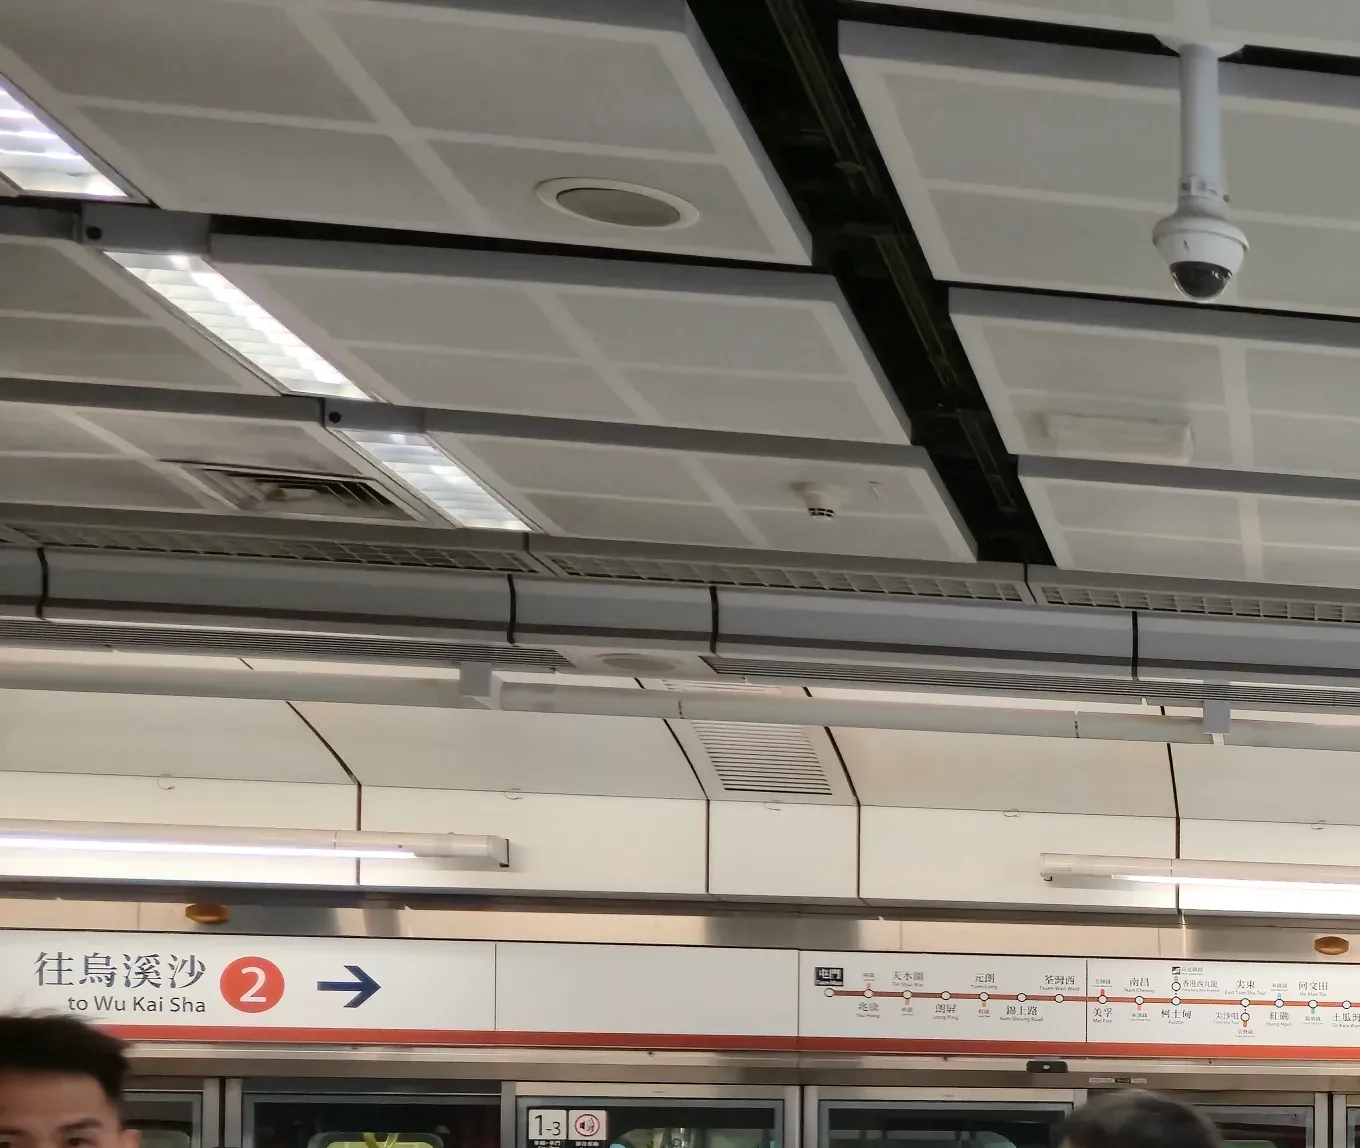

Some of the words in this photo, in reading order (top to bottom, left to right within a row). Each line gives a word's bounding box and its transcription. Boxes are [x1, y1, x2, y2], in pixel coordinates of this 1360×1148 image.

[34, 951, 206, 989] 往烏溪沙
[240, 966, 267, 1003] 2
[68, 997, 88, 1011] to
[94, 996, 126, 1011] Wu
[133, 996, 163, 1012] Kai
[170, 997, 206, 1013] Sha
[534, 1114, 561, 1136] 1-3
